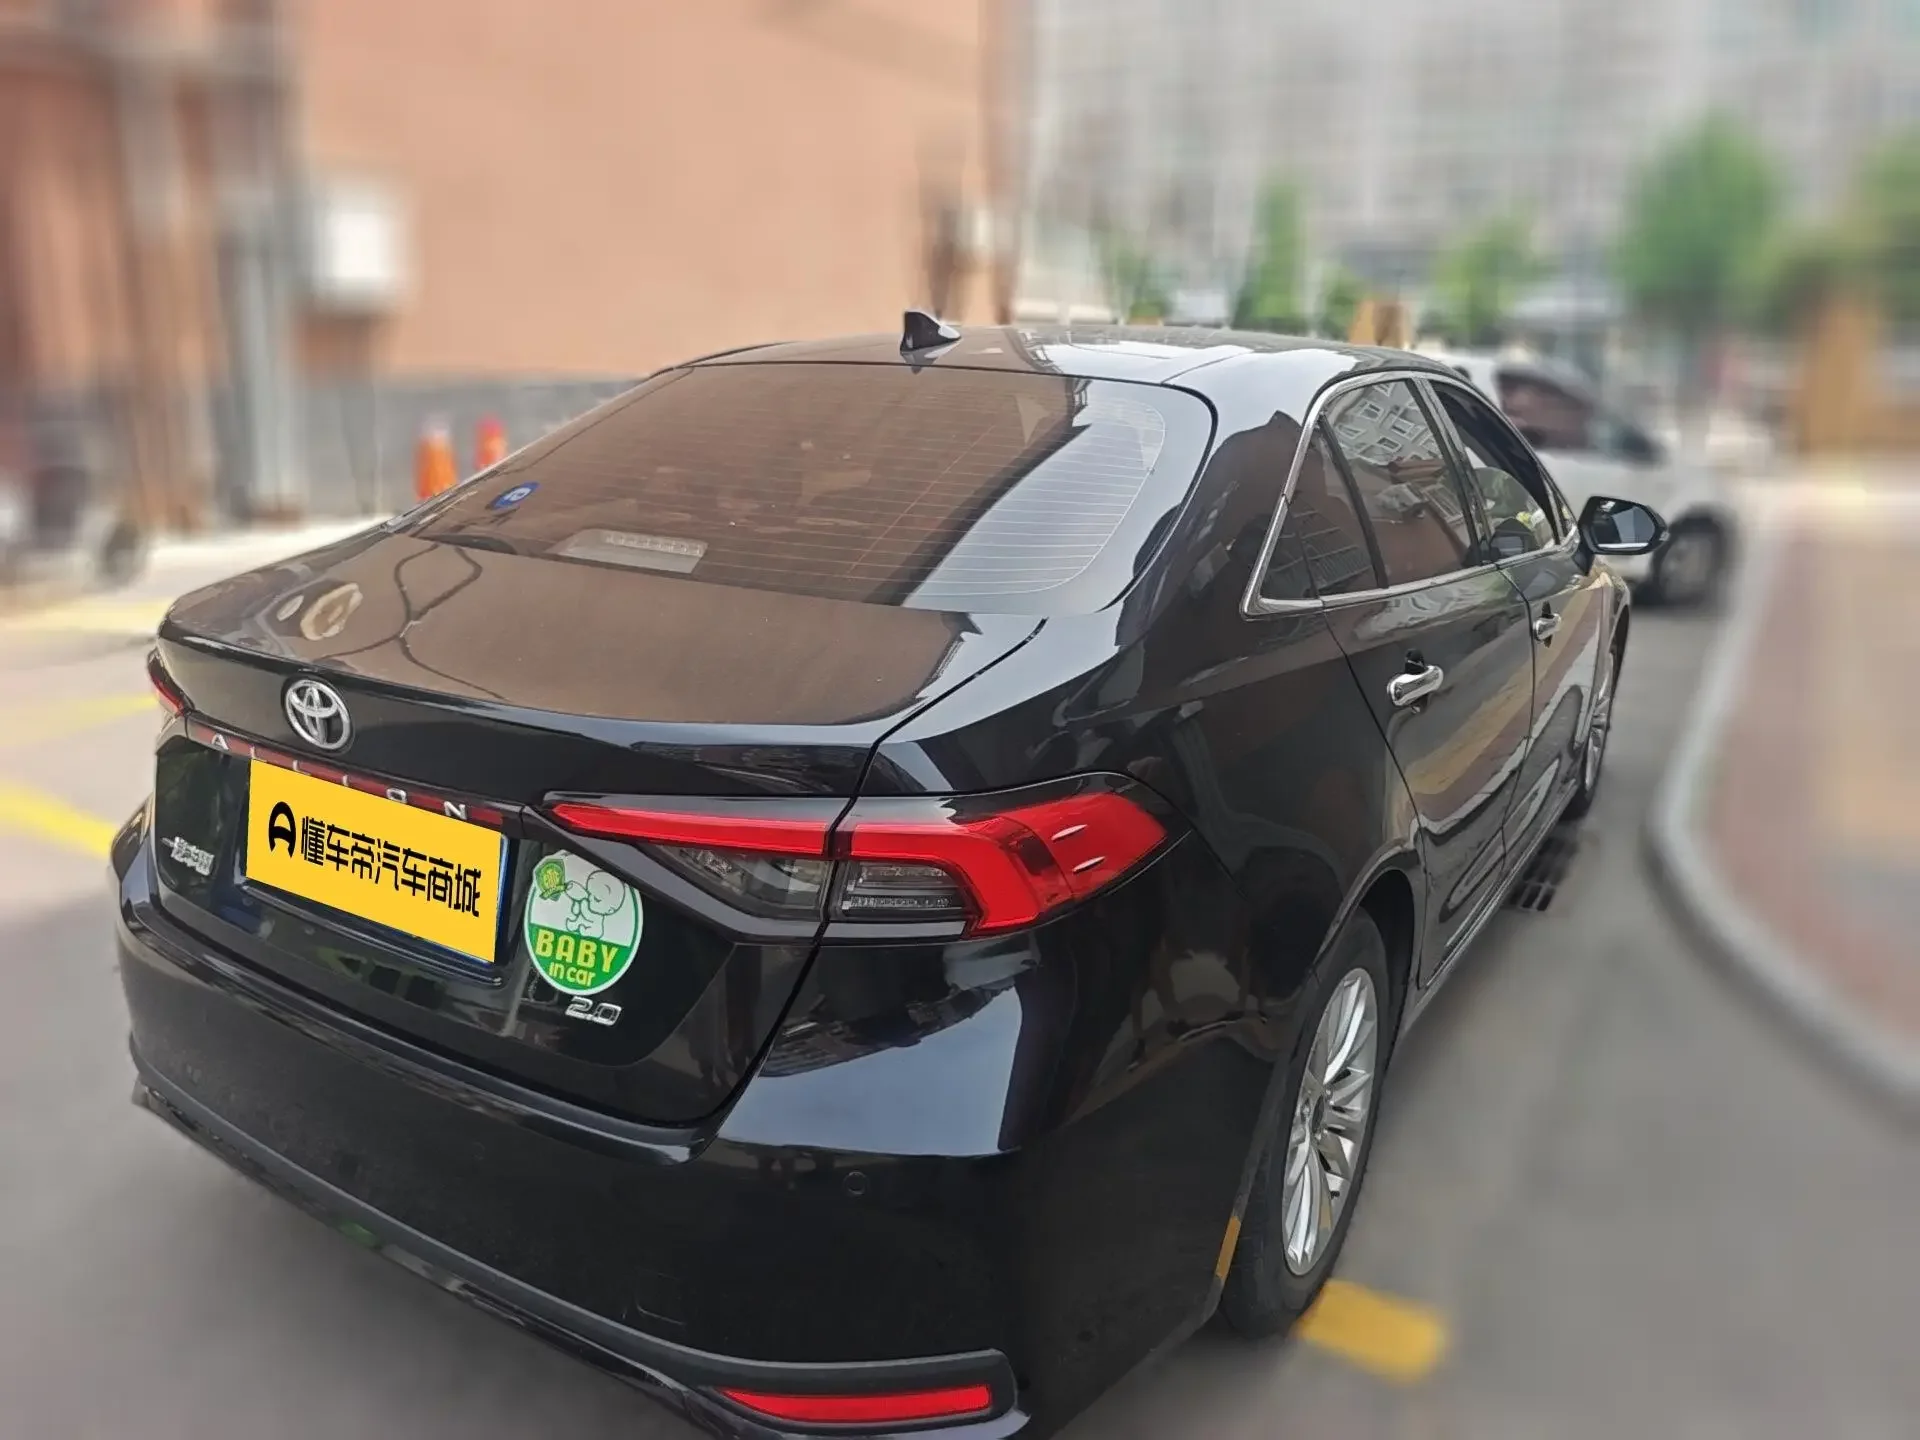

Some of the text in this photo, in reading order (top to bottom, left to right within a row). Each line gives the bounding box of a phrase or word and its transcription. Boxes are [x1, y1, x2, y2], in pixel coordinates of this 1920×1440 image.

[211, 733, 467, 820] ALLION
[535, 929, 619, 973] BABY
[549, 961, 596, 987] in car
[565, 995, 622, 1027] 2.0
